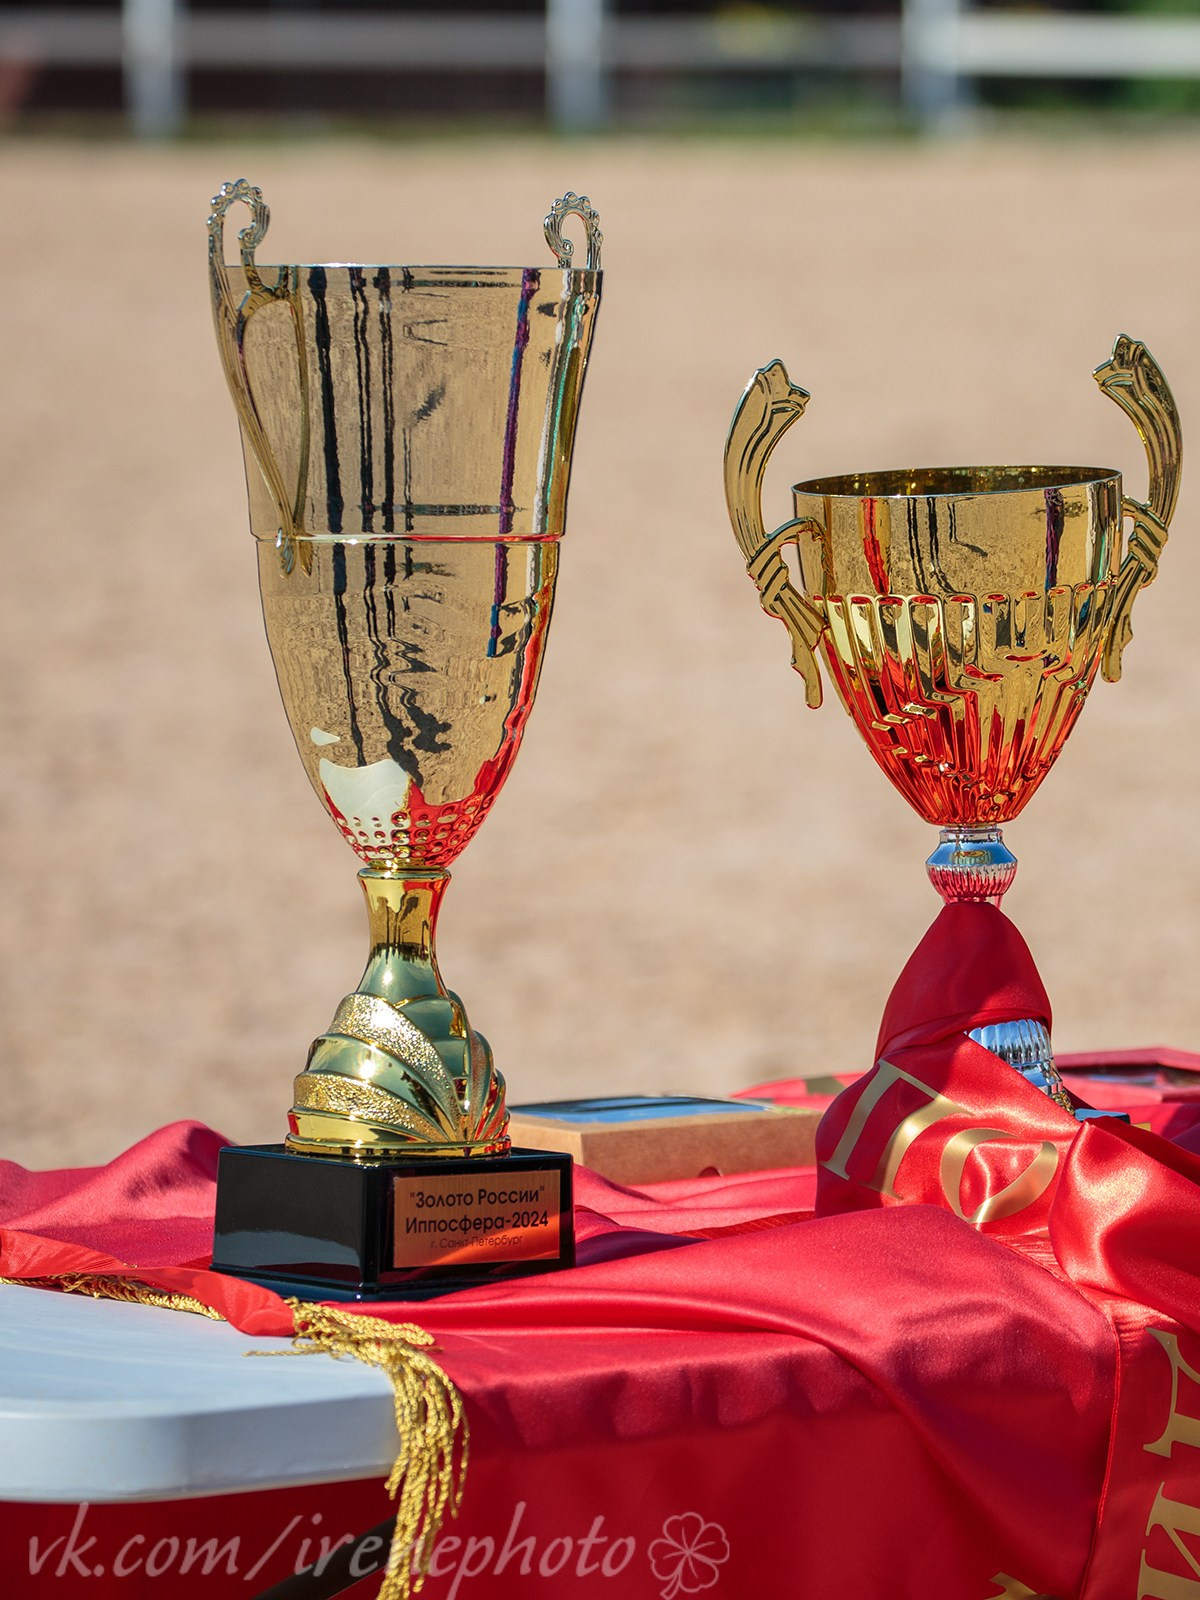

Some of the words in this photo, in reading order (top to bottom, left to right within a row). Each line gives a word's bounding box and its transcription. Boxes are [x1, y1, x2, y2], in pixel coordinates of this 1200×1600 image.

[410, 1191, 473, 1209] "Золото
[478, 1185, 545, 1206] России"
[405, 1210, 549, 1235] Иппосфера-2024
[439, 1234, 524, 1249] Санкт-Петербург
